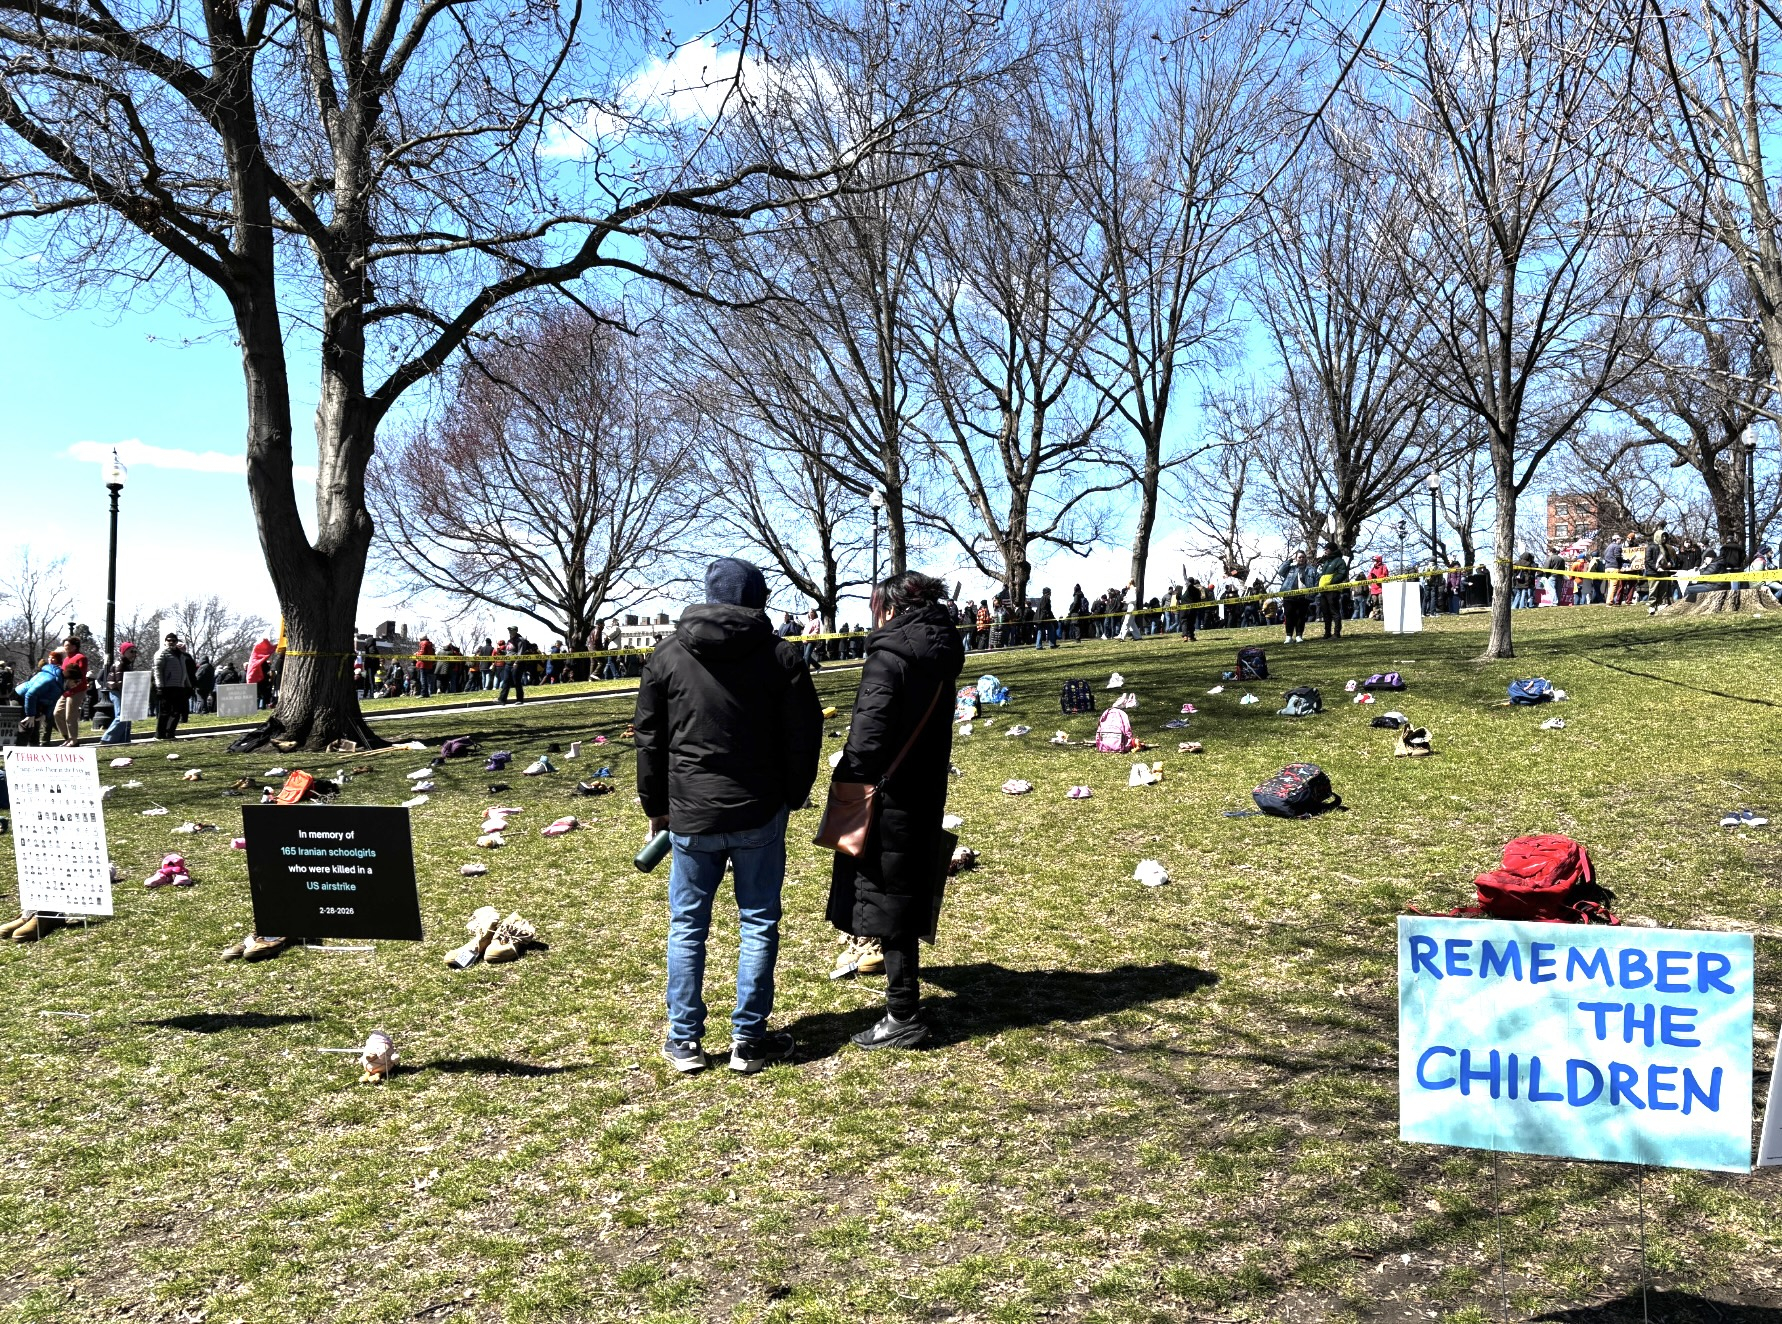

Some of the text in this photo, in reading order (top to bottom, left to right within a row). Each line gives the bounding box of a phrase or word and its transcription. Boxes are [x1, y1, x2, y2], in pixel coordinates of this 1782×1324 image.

[15, 752, 85, 763] TEHRAN TIMES
[299, 830, 354, 840] In memory of
[281, 847, 376, 858] 165 Iranian schoolgirls
[288, 864, 373, 875] who were killed in a
[306, 882, 356, 891] US airstrike
[1408, 935, 1735, 994] REMEMBER
[1578, 1001, 1702, 1048] THE
[1416, 1045, 1723, 1115] CHILDREN
